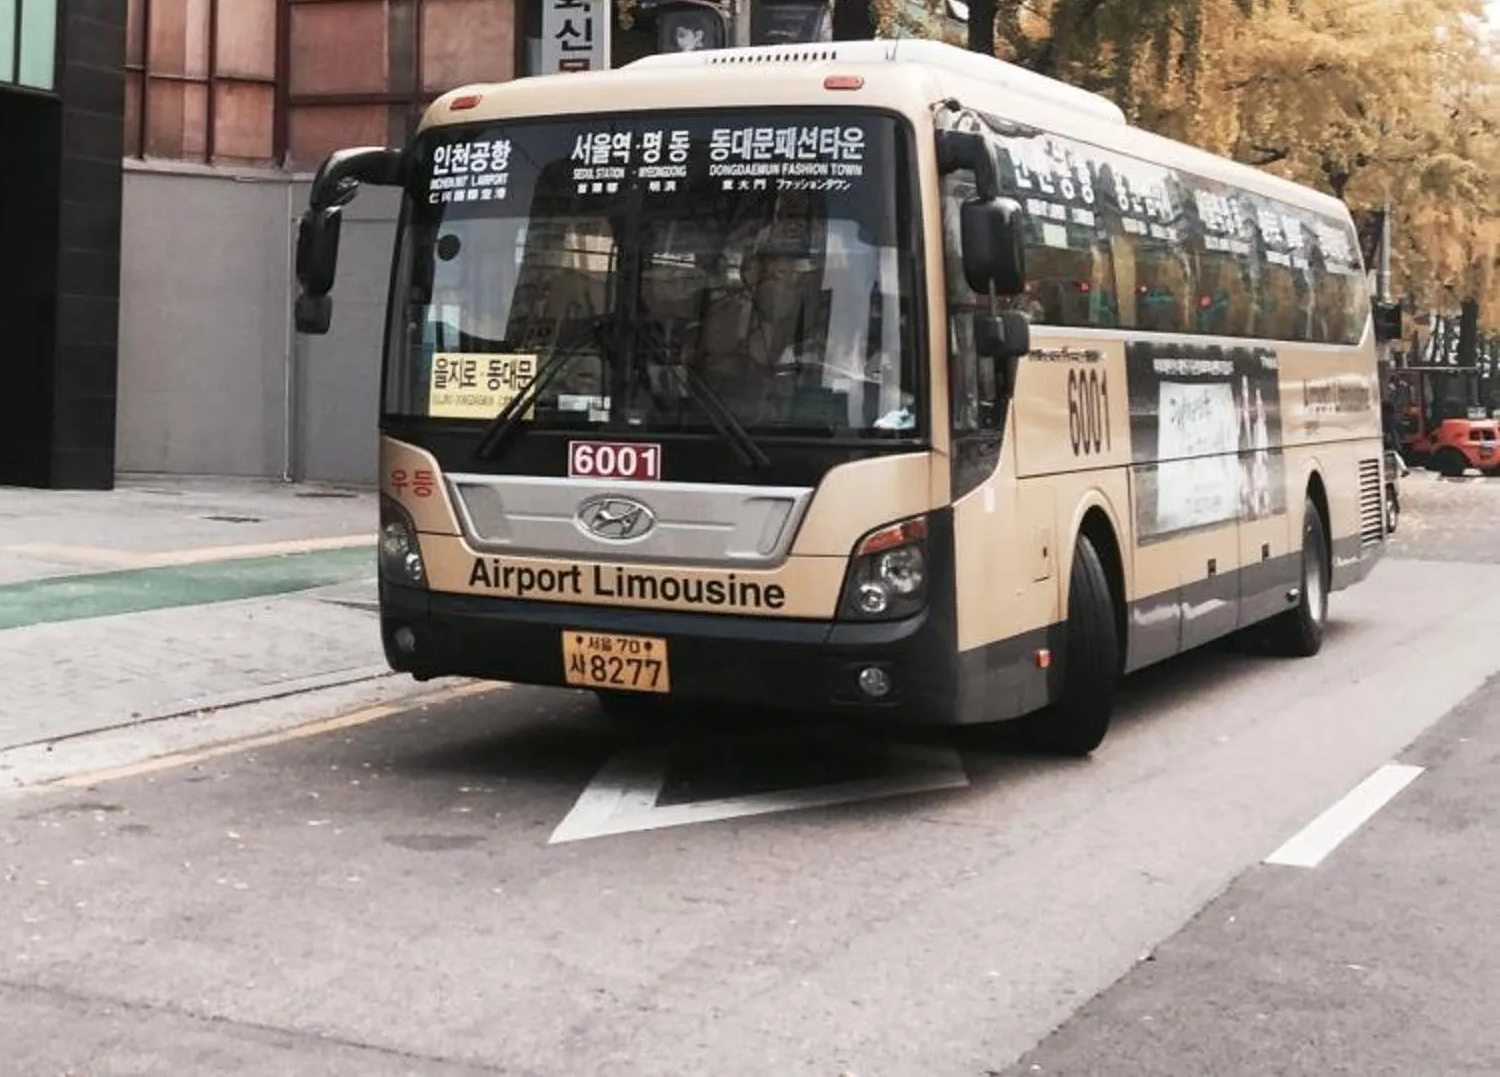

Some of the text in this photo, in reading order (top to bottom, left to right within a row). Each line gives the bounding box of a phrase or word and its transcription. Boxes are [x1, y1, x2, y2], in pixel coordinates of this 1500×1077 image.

[433, 139, 511, 175] 인천공항
[571, 131, 632, 165] 서울역
[709, 126, 865, 162] 동대문패션타운
[781, 162, 828, 176] FASHION
[831, 162, 863, 176] TOWN
[434, 357, 533, 391] 을지로 동대문
[1067, 367, 1112, 457] 6001
[573, 444, 657, 477] 6001
[468, 556, 786, 609] Airport Limousine
[617, 638, 640, 654] 70
